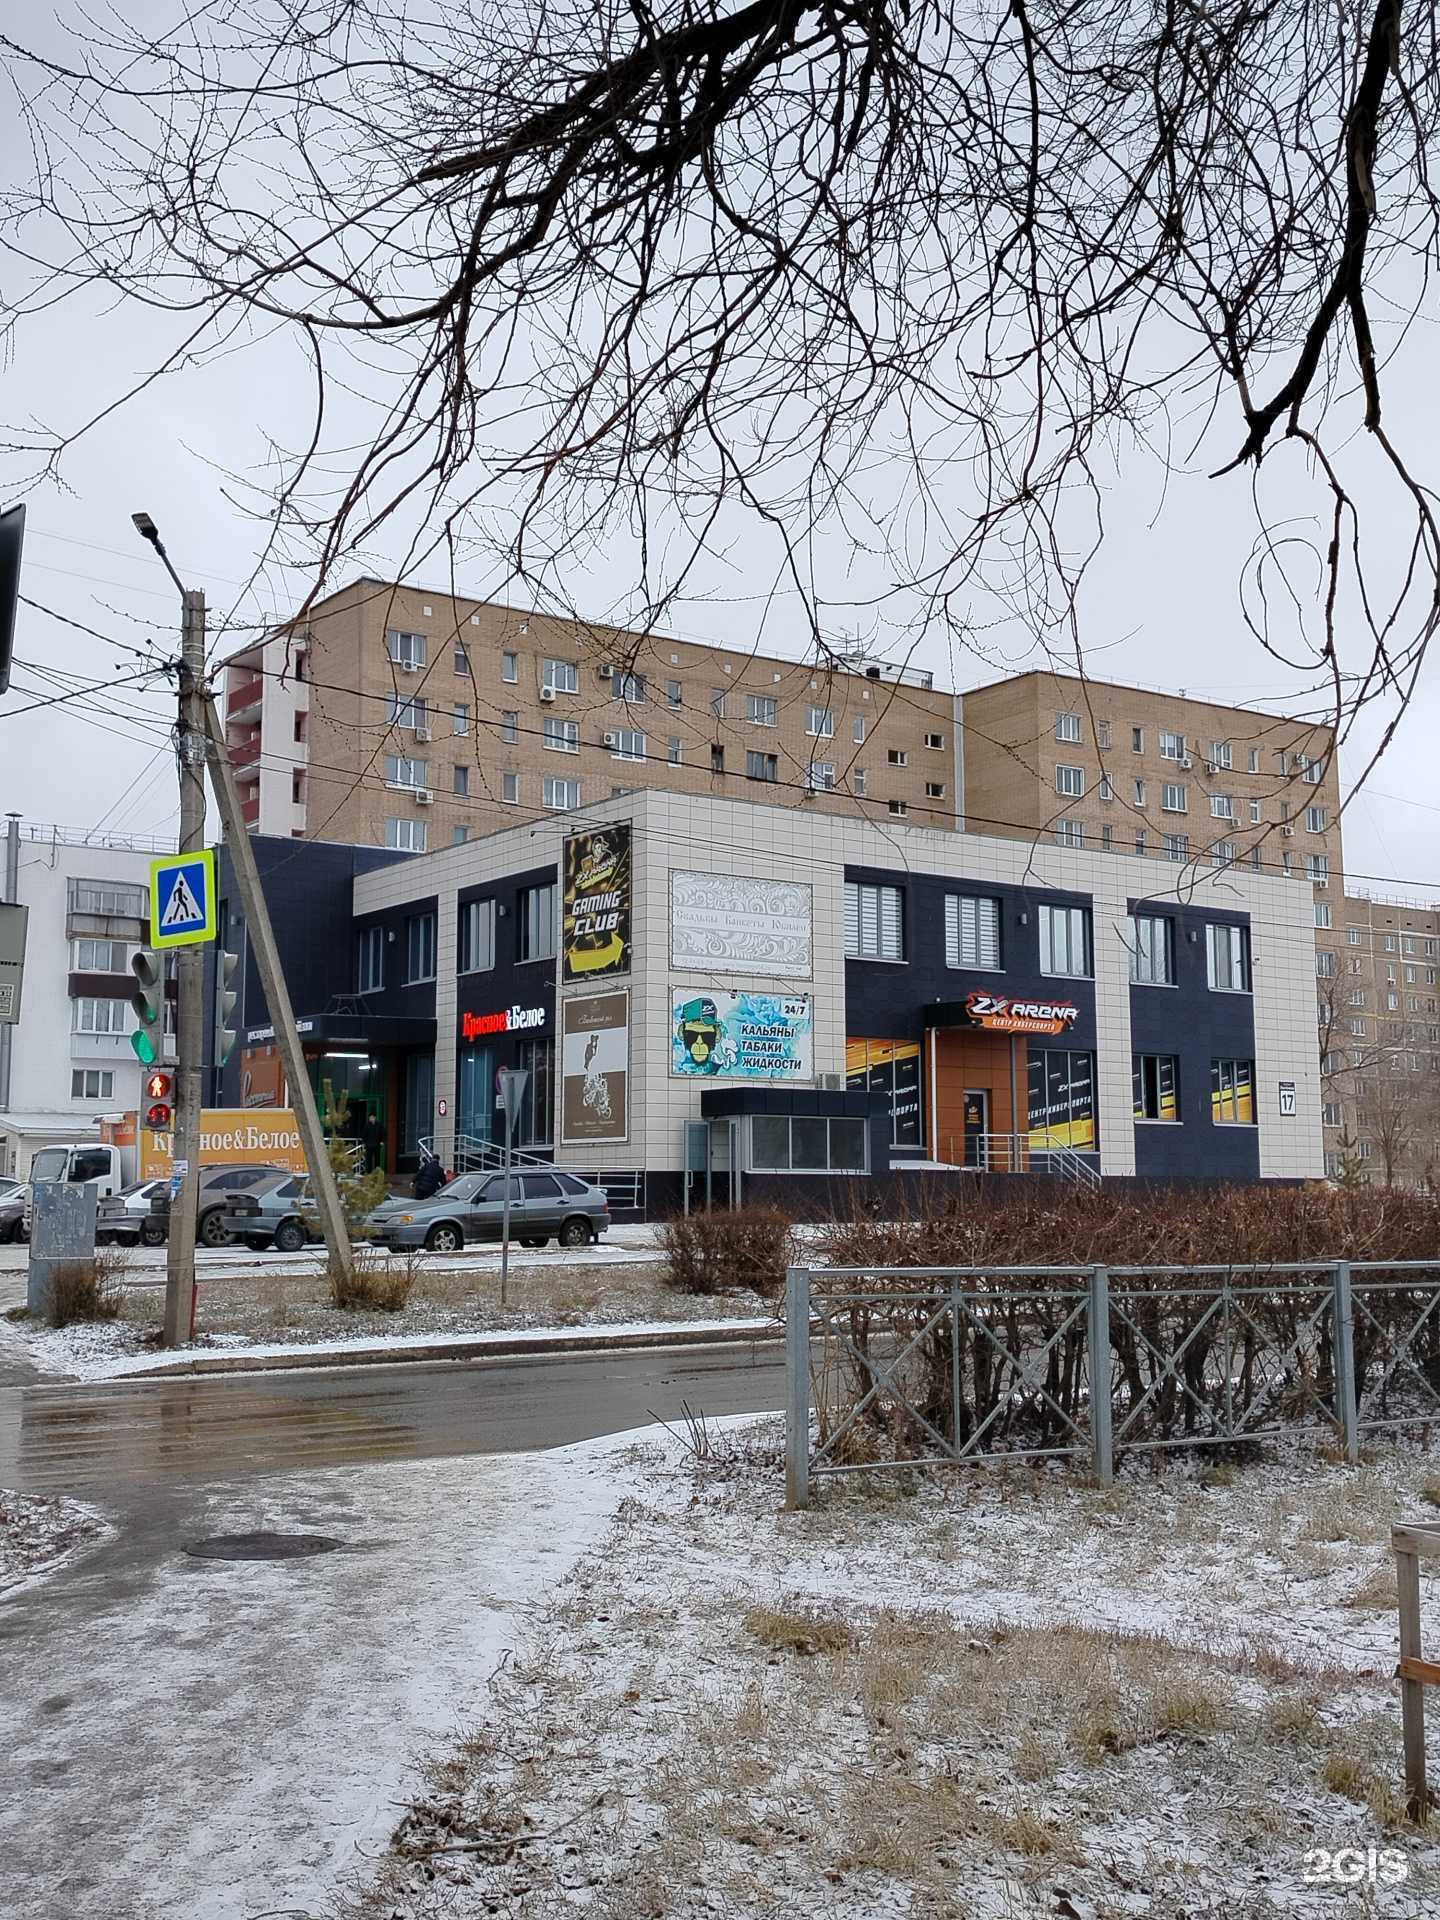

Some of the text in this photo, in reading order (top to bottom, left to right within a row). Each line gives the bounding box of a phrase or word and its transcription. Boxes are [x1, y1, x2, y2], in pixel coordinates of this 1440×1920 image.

[571, 890, 622, 916] GAMING
[573, 912, 620, 937] CLUB
[784, 1004, 806, 1015] 24/7
[970, 996, 1009, 1015] ZX
[741, 1024, 795, 1038] КАЛЬЯНЫ
[992, 1018, 1056, 1031] ЦЕНТР КИБЕРСПОРТА
[741, 1041, 783, 1053] ТАБАКИ
[742, 1056, 801, 1070] ЖИДКОСТИ
[1282, 1094, 1294, 1111] 17
